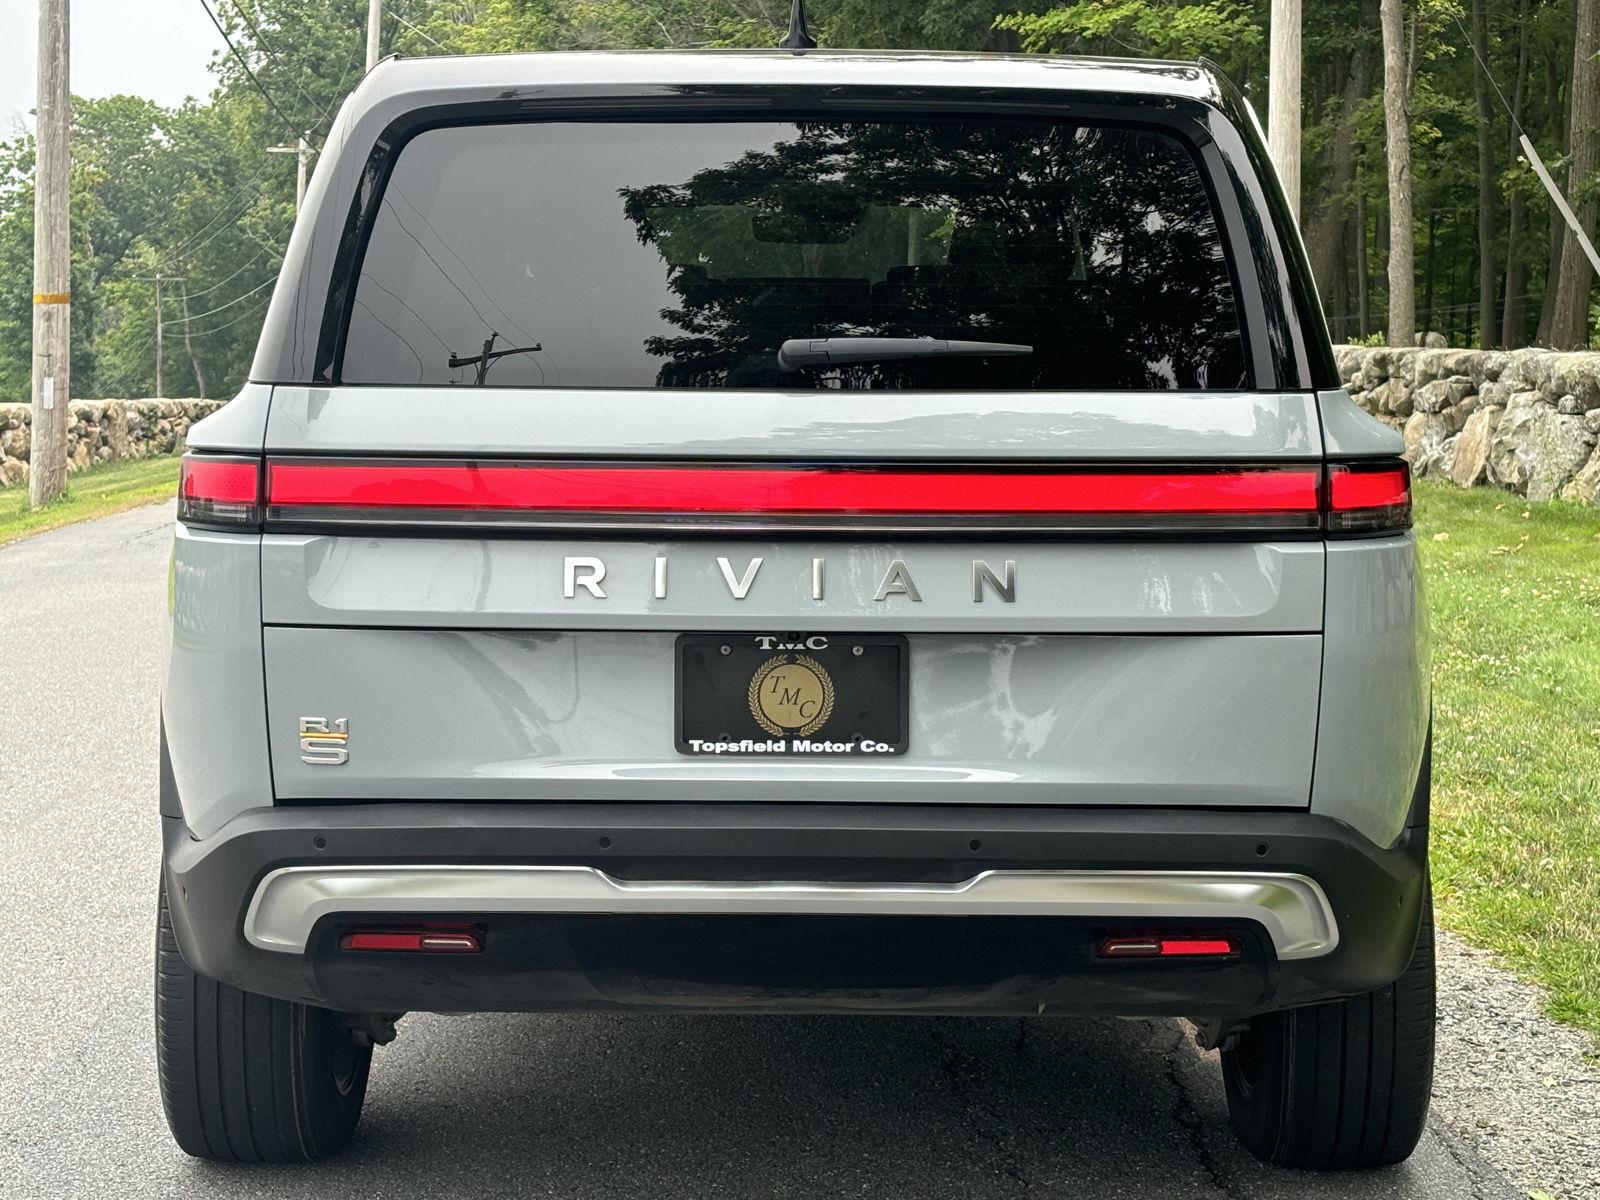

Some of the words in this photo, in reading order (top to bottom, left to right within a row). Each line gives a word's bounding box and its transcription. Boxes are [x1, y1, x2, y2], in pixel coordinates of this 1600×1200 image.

[563, 556, 1016, 602] RIVIAN
[299, 716, 348, 733] R1
[300, 737, 349, 765] S
[689, 740, 786, 753] Topsfield
[792, 740, 855, 752] Motor
[860, 740, 895, 753] Co.
